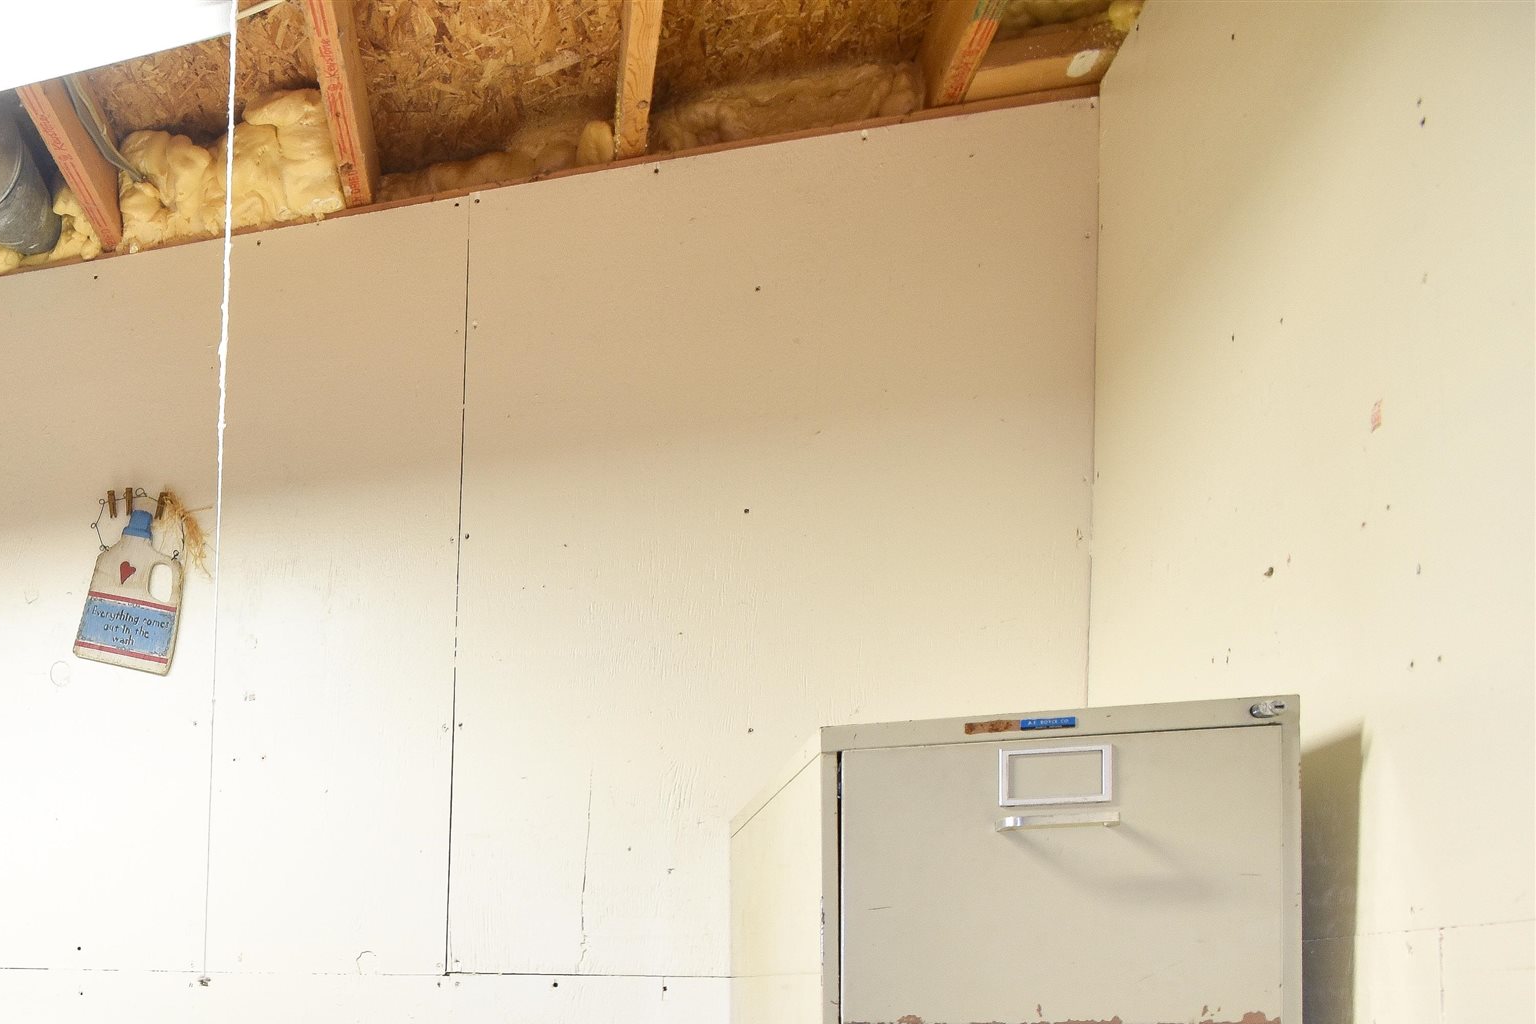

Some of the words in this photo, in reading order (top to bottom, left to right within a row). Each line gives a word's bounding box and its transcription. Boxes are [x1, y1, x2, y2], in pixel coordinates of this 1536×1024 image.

[91, 605, 140, 625] Everything
[143, 617, 170, 630] comes
[104, 623, 119, 632] out
[135, 626, 149, 638] the
[112, 635, 134, 645] wash
